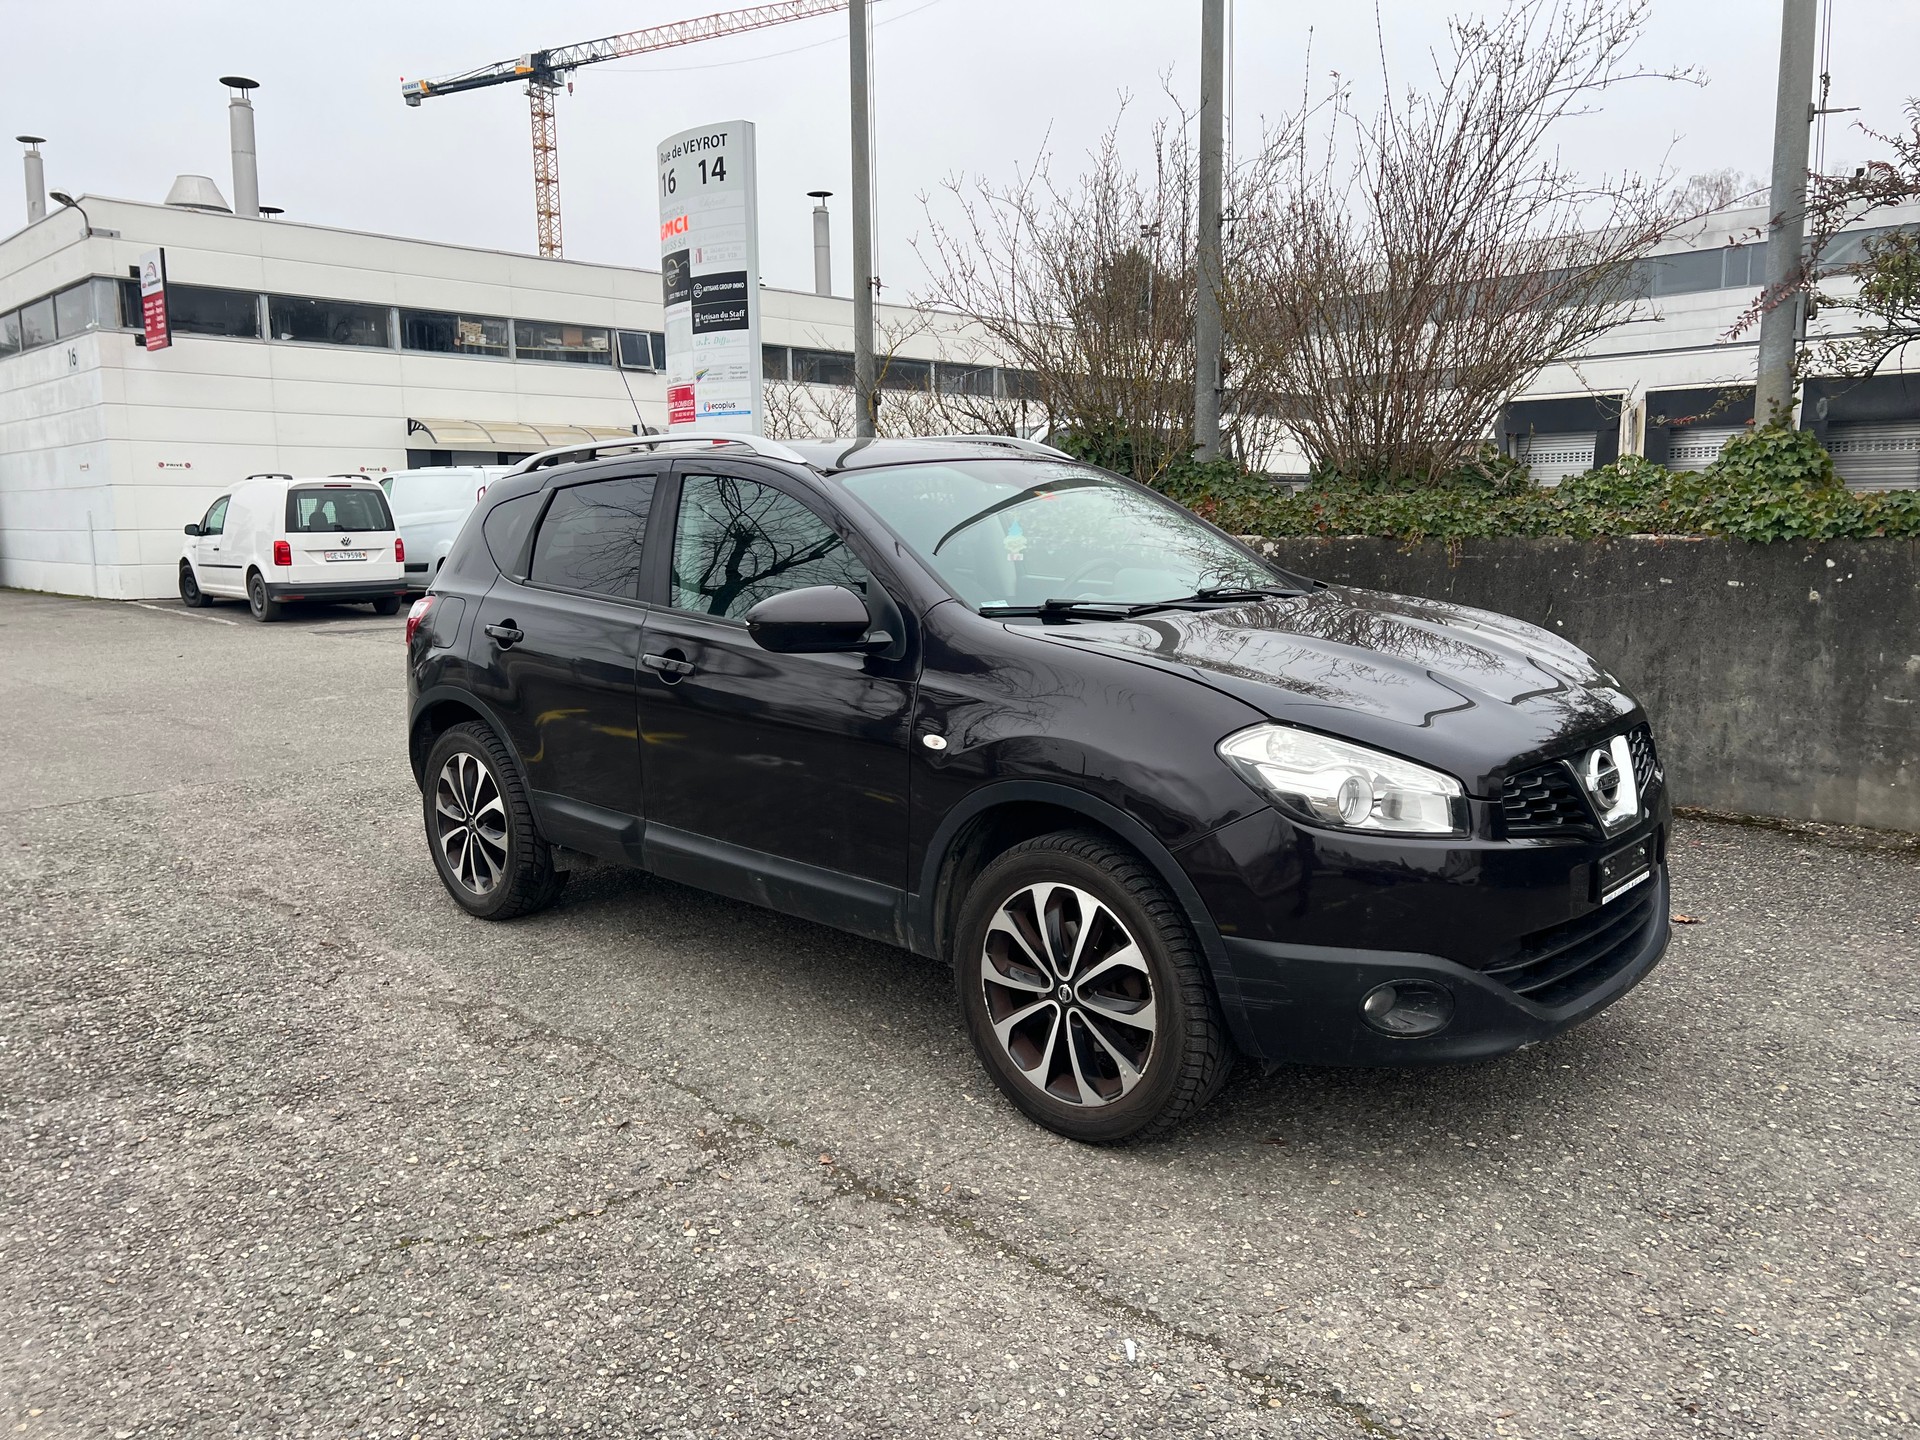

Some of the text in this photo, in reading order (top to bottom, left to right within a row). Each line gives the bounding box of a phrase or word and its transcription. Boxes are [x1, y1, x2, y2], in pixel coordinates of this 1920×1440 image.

[402, 82, 419, 90] PERRET
[661, 133, 728, 166] Rue de VEYROT
[698, 156, 727, 184] 14
[662, 167, 676, 197] 16
[729, 309, 745, 318] Staff
[67, 347, 76, 367] 16
[711, 401, 736, 410] ecoplus
